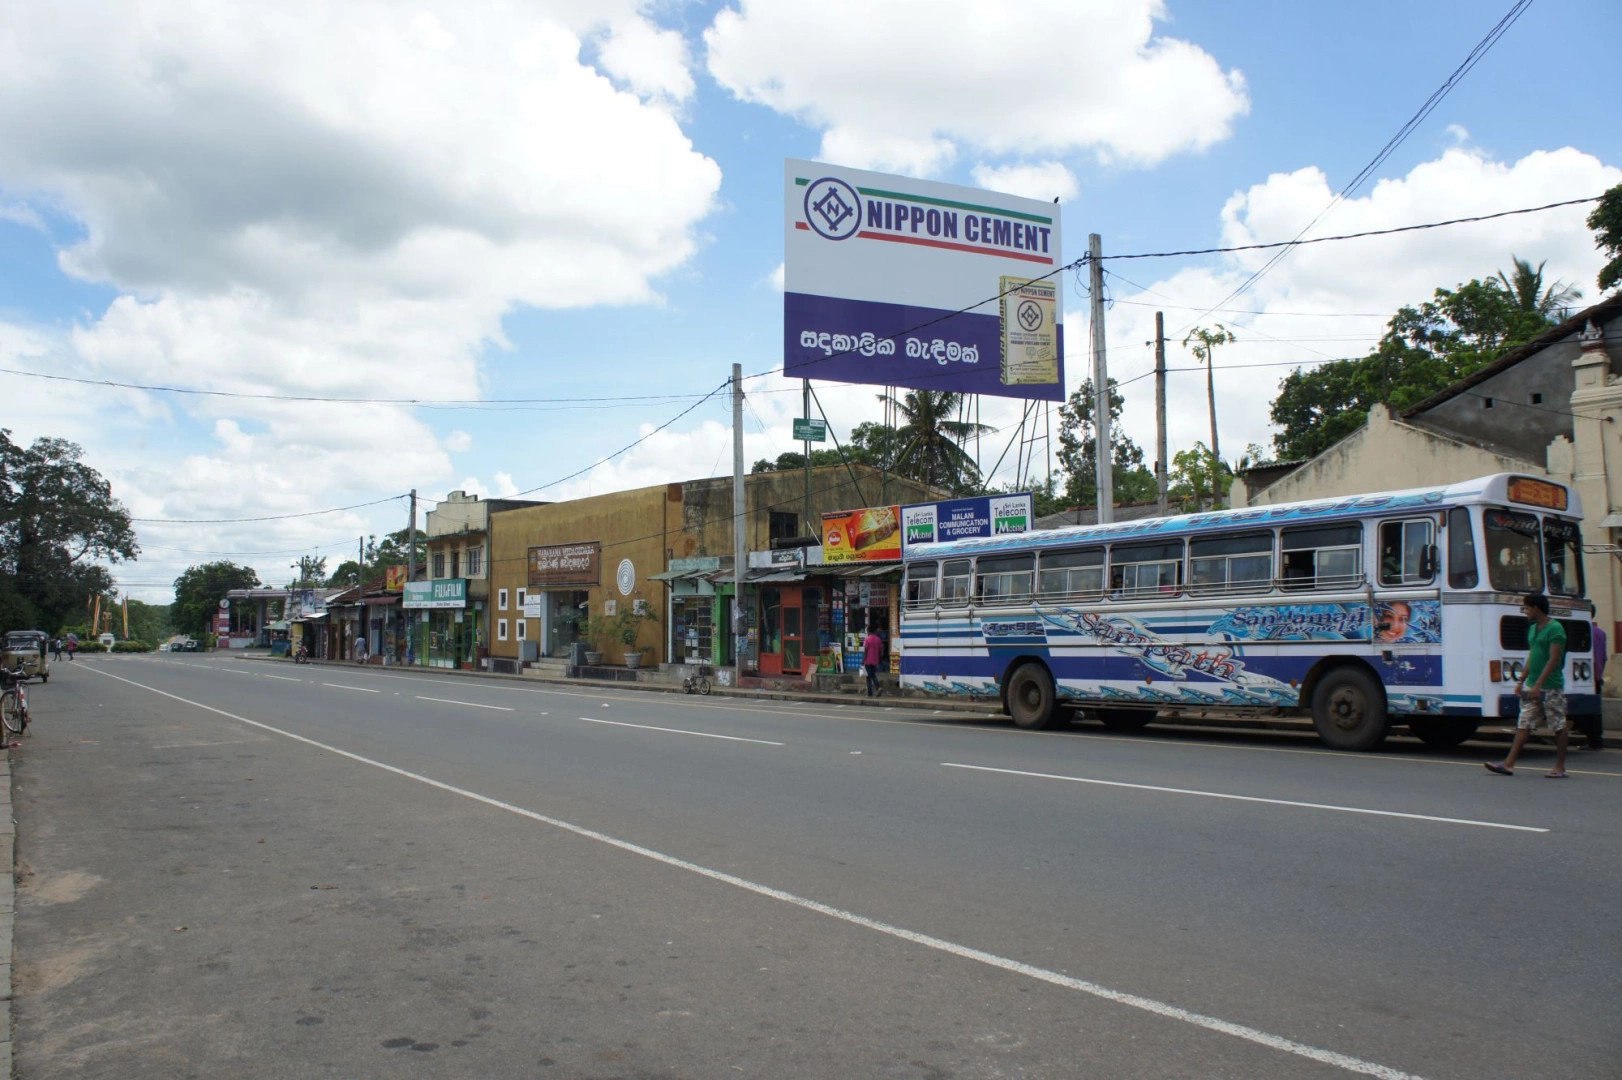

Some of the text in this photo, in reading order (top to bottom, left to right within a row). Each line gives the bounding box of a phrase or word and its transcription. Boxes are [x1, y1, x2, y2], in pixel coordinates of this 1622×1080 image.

[867, 200, 1051, 254] NIPPON CEMENT
[952, 512, 974, 521] MALANI
[994, 504, 1027, 517] Telecom
[907, 513, 934, 525] Telecom
[939, 518, 989, 530] COMMUNICATION
[946, 526, 981, 536] & GROCERY
[997, 520, 1025, 535] Mobitel
[909, 528, 932, 541] Mobitel
